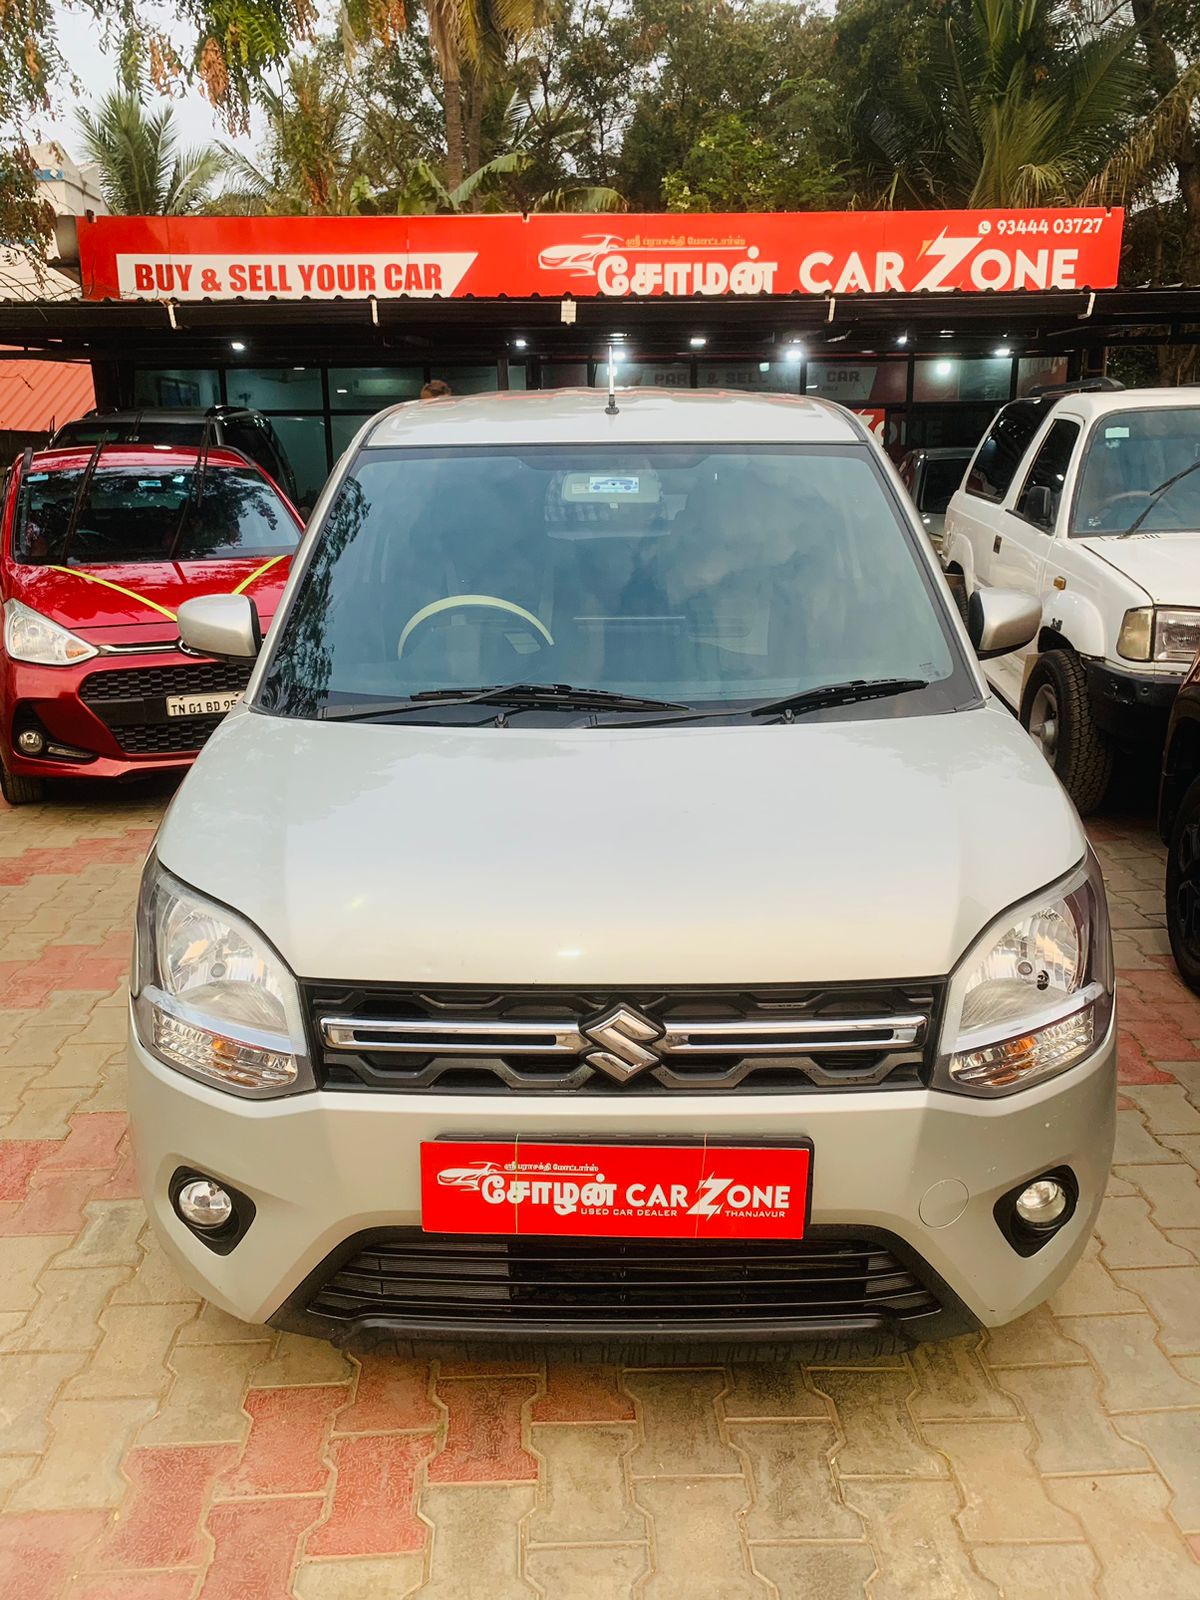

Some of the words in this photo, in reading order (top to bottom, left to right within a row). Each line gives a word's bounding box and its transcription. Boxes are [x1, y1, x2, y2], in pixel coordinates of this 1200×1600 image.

[996, 219, 1049, 235] 93444
[1053, 217, 1103, 234] 03727
[799, 251, 905, 294] CAR
[911, 226, 1079, 293] ZONE
[134, 263, 192, 292] BUY
[200, 268, 223, 291] &
[229, 264, 292, 292] SELL
[297, 264, 376, 291] YOUR
[384, 263, 443, 291] CAR
[826, 370, 861, 383] CAR
[171, 704, 186, 714] TN
[189, 703, 203, 713] 01
[206, 701, 221, 712] BD
[482, 1173, 617, 1216] சோழன்
[625, 1184, 688, 1208] CAR
[685, 1171, 791, 1222] ZONE
[580, 1208, 609, 1216] USED
[613, 1208, 634, 1216] CAR
[637, 1209, 678, 1217] DEALER
[724, 1210, 786, 1218] THANJAVUR
